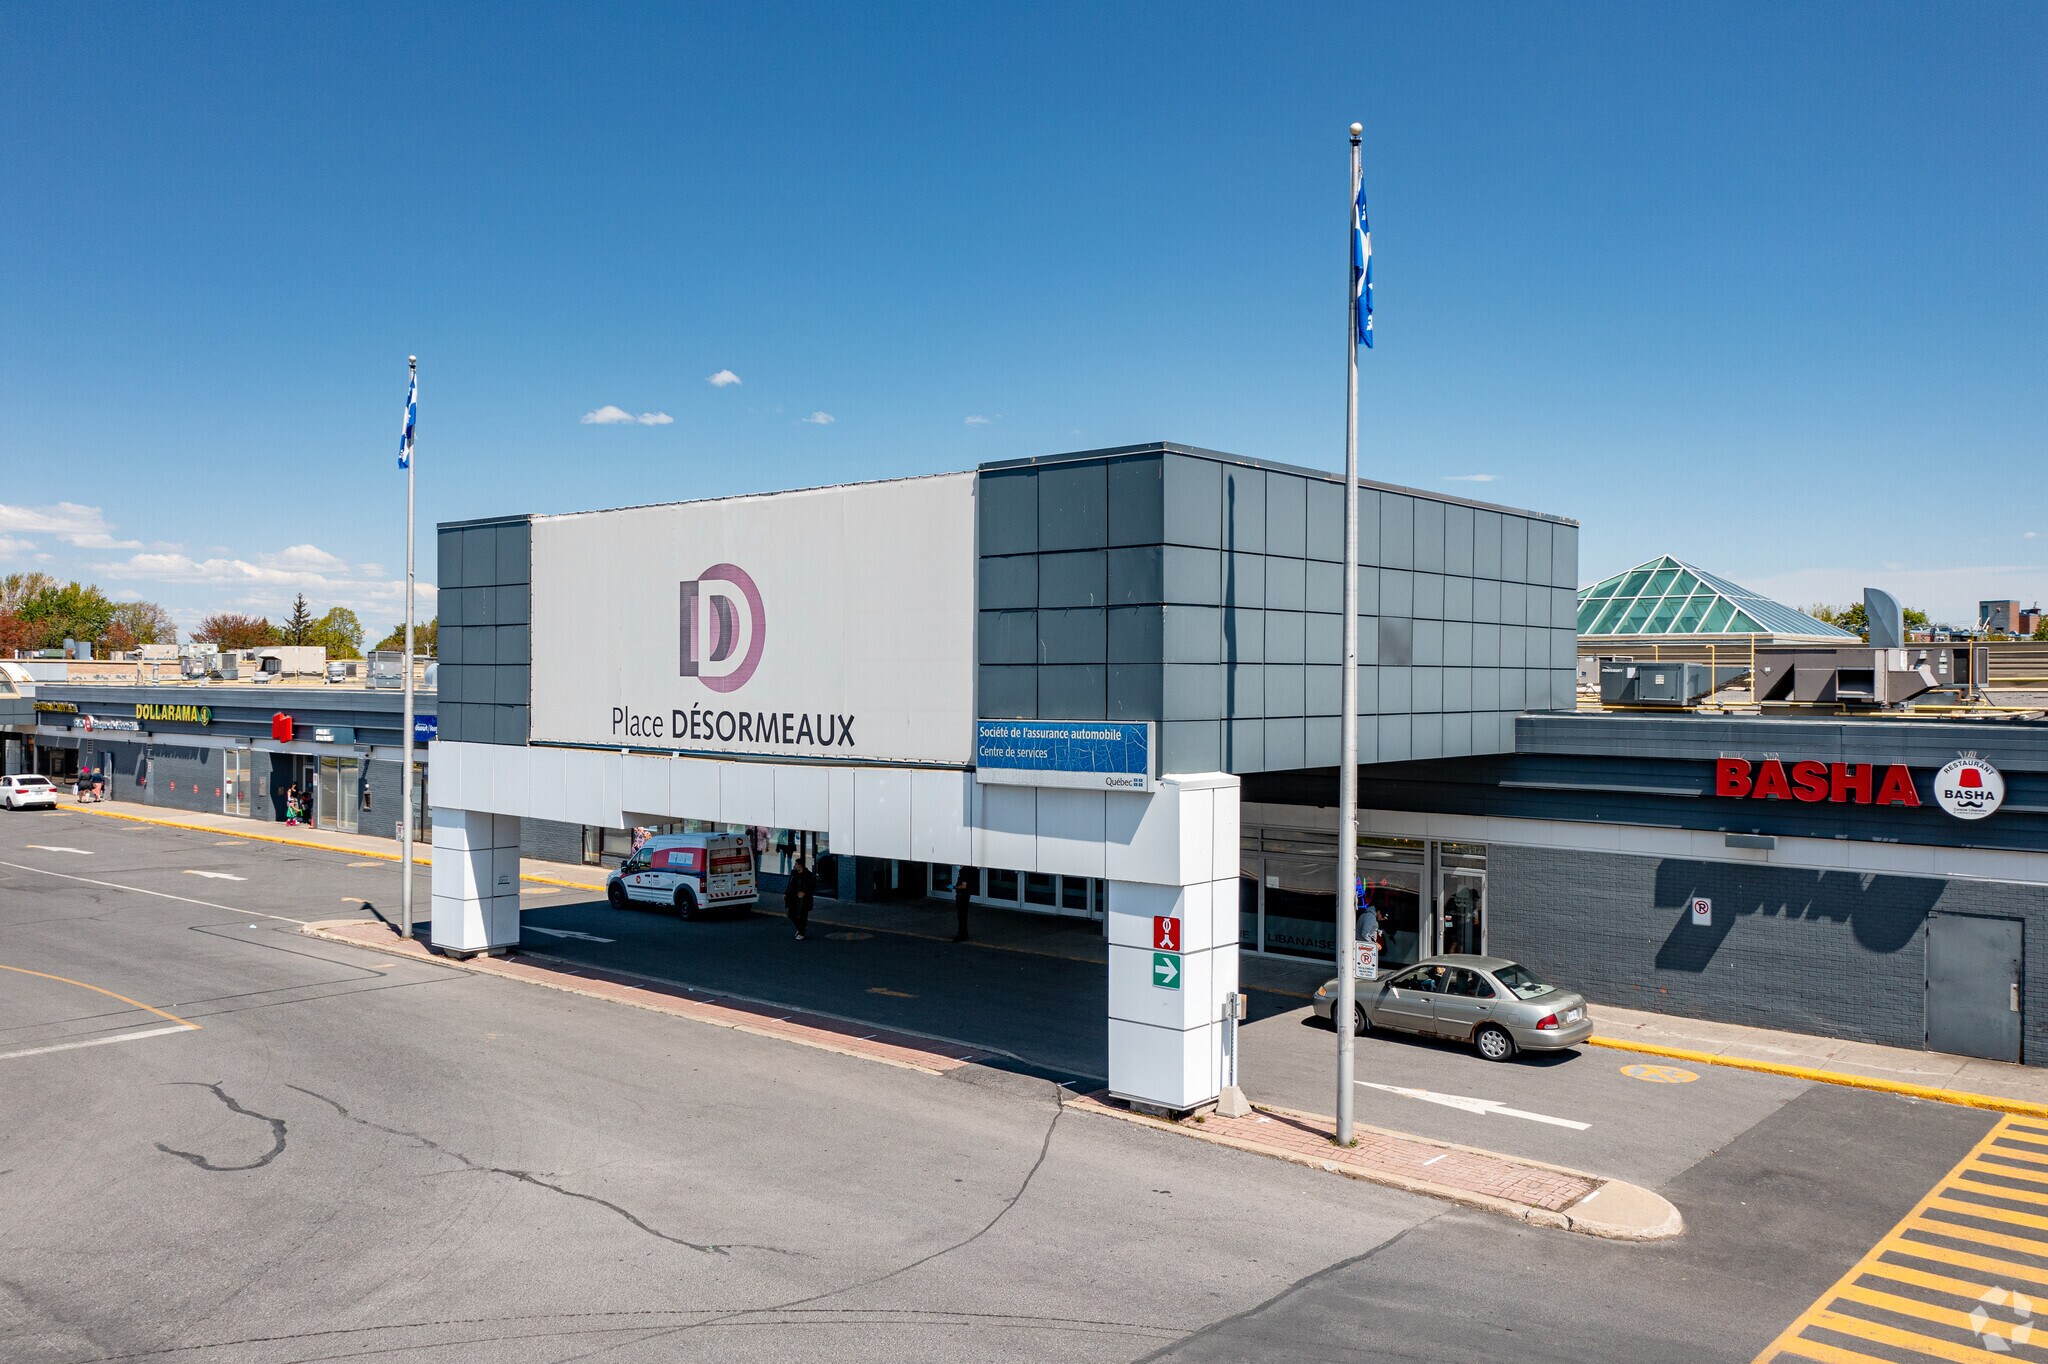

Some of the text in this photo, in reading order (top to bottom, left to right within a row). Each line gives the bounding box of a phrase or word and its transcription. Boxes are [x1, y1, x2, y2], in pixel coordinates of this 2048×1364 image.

[135, 703, 198, 722] DOLLARAMA
[612, 702, 855, 747] Place DÉSORMEAUX
[979, 726, 1122, 741] Société de l'assurance automobile
[979, 746, 1048, 759] Centre de services
[1943, 760, 1995, 775] RESTAURANT
[1105, 776, 1133, 787] Québec
[1716, 757, 1921, 806] BASHA
[1944, 789, 1995, 801] BASHA
[1267, 933, 1336, 950] LIBANAISE
